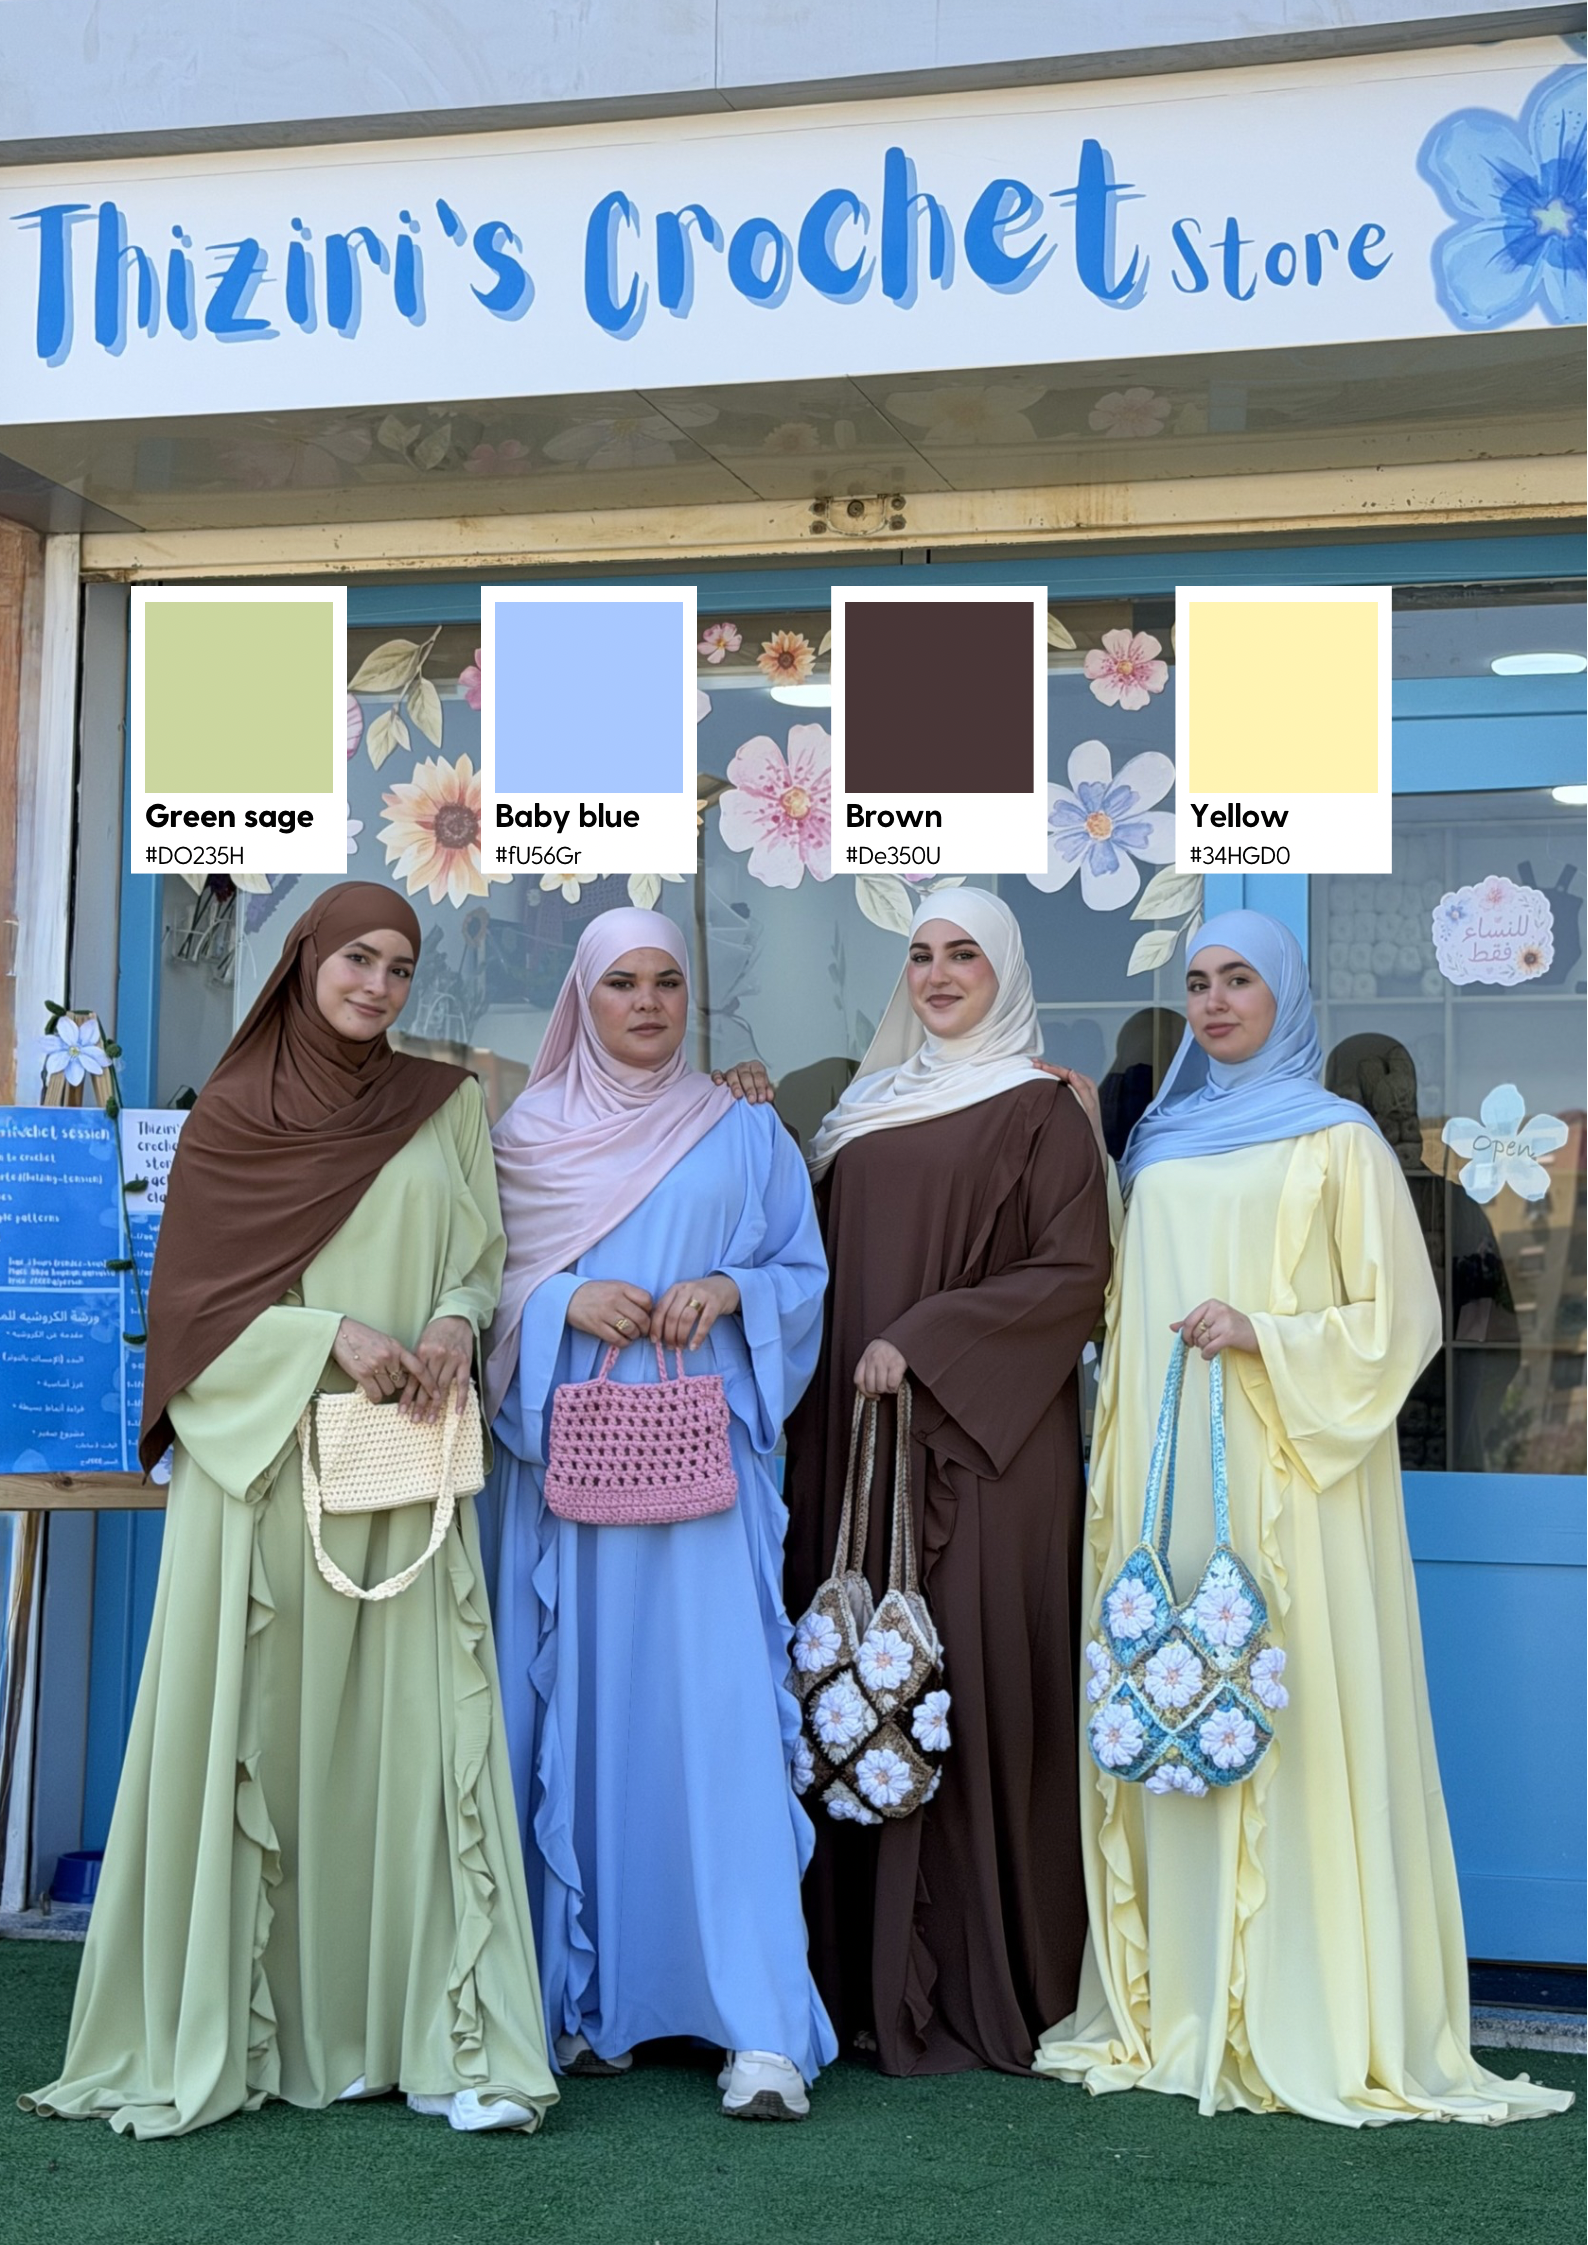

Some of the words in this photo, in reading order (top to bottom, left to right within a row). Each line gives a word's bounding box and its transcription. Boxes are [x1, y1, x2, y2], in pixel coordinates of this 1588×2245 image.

[9, 198, 535, 368] Thiziri's
[585, 139, 1149, 340] Crochet
[1171, 217, 1394, 301] Store
[1462, 915, 1529, 942] للنساء
[1468, 942, 1512, 963] فقط
[138, 1121, 180, 1136] Thiziri'
[137, 1139, 178, 1152] croche
[1473, 1135, 1536, 1162] Open
[145, 1157, 172, 1170] stor
[19, 1310, 67, 1324] الكروشيه
[70, 1311, 100, 1325] ورشة
